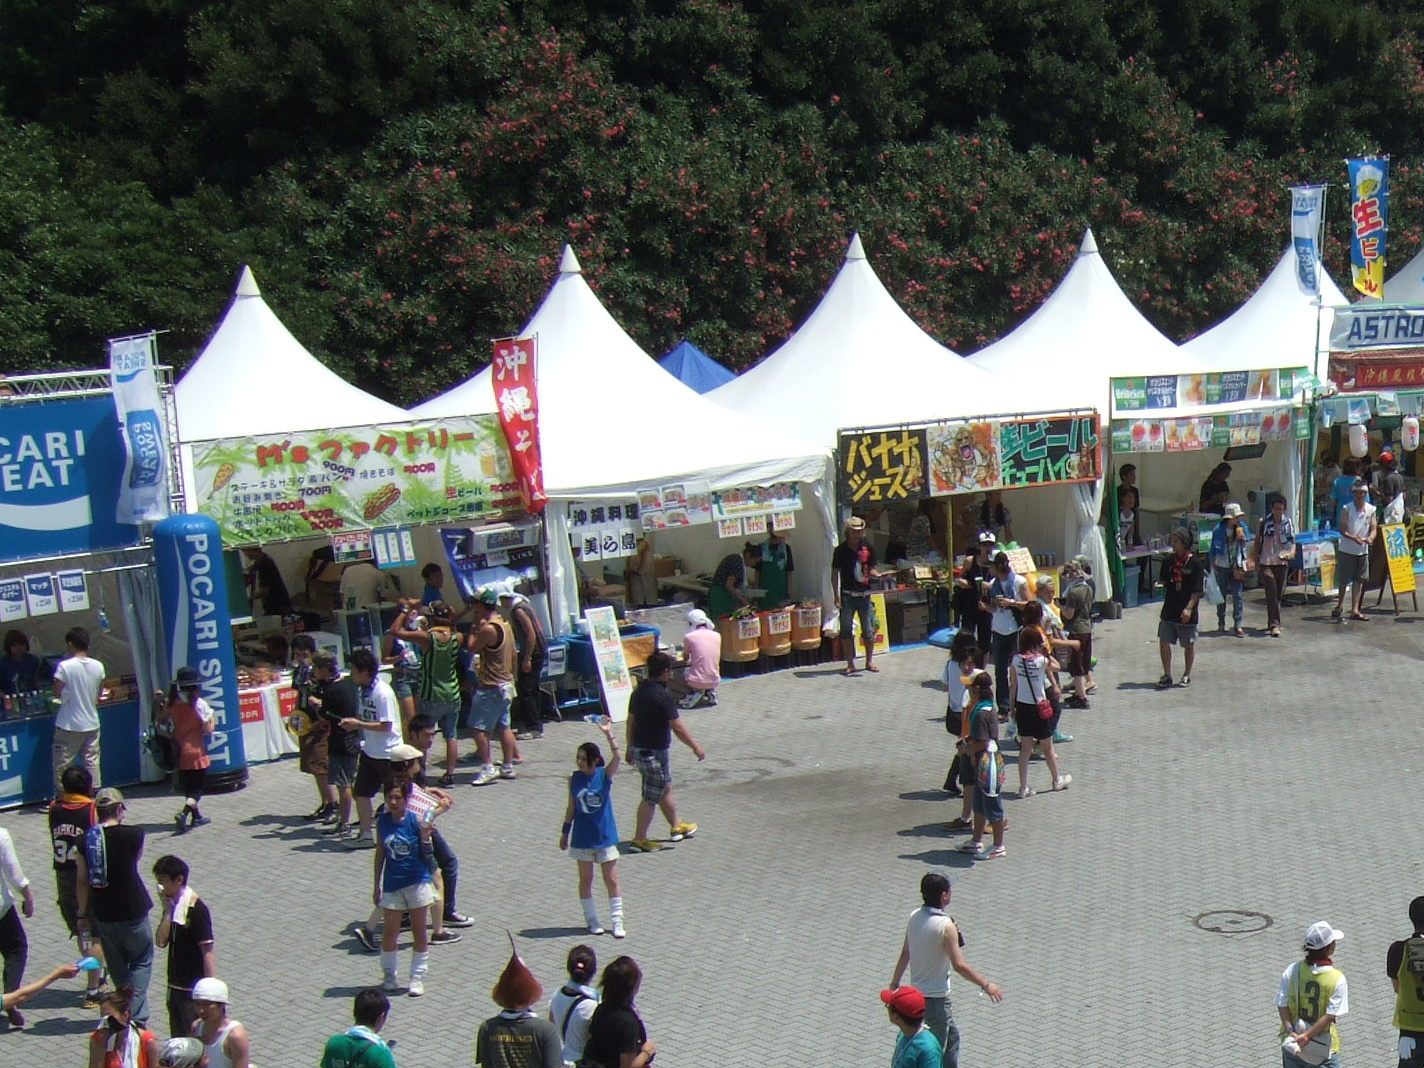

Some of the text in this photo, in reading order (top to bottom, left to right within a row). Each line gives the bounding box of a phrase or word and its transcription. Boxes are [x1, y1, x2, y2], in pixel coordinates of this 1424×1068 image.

[1352, 198, 1384, 293] 生ビール
[256, 428, 474, 468] M's ファクトリー
[2, 459, 74, 492] EAT
[322, 460, 355, 477] 900円
[848, 466, 909, 502] ジュース
[298, 485, 332, 498] 700円
[573, 503, 640, 527] 沖縄料理
[584, 532, 636, 556] 美ら島
[186, 533, 232, 765] POCARI SWEAT
[1302, 980, 1321, 1023] 3
